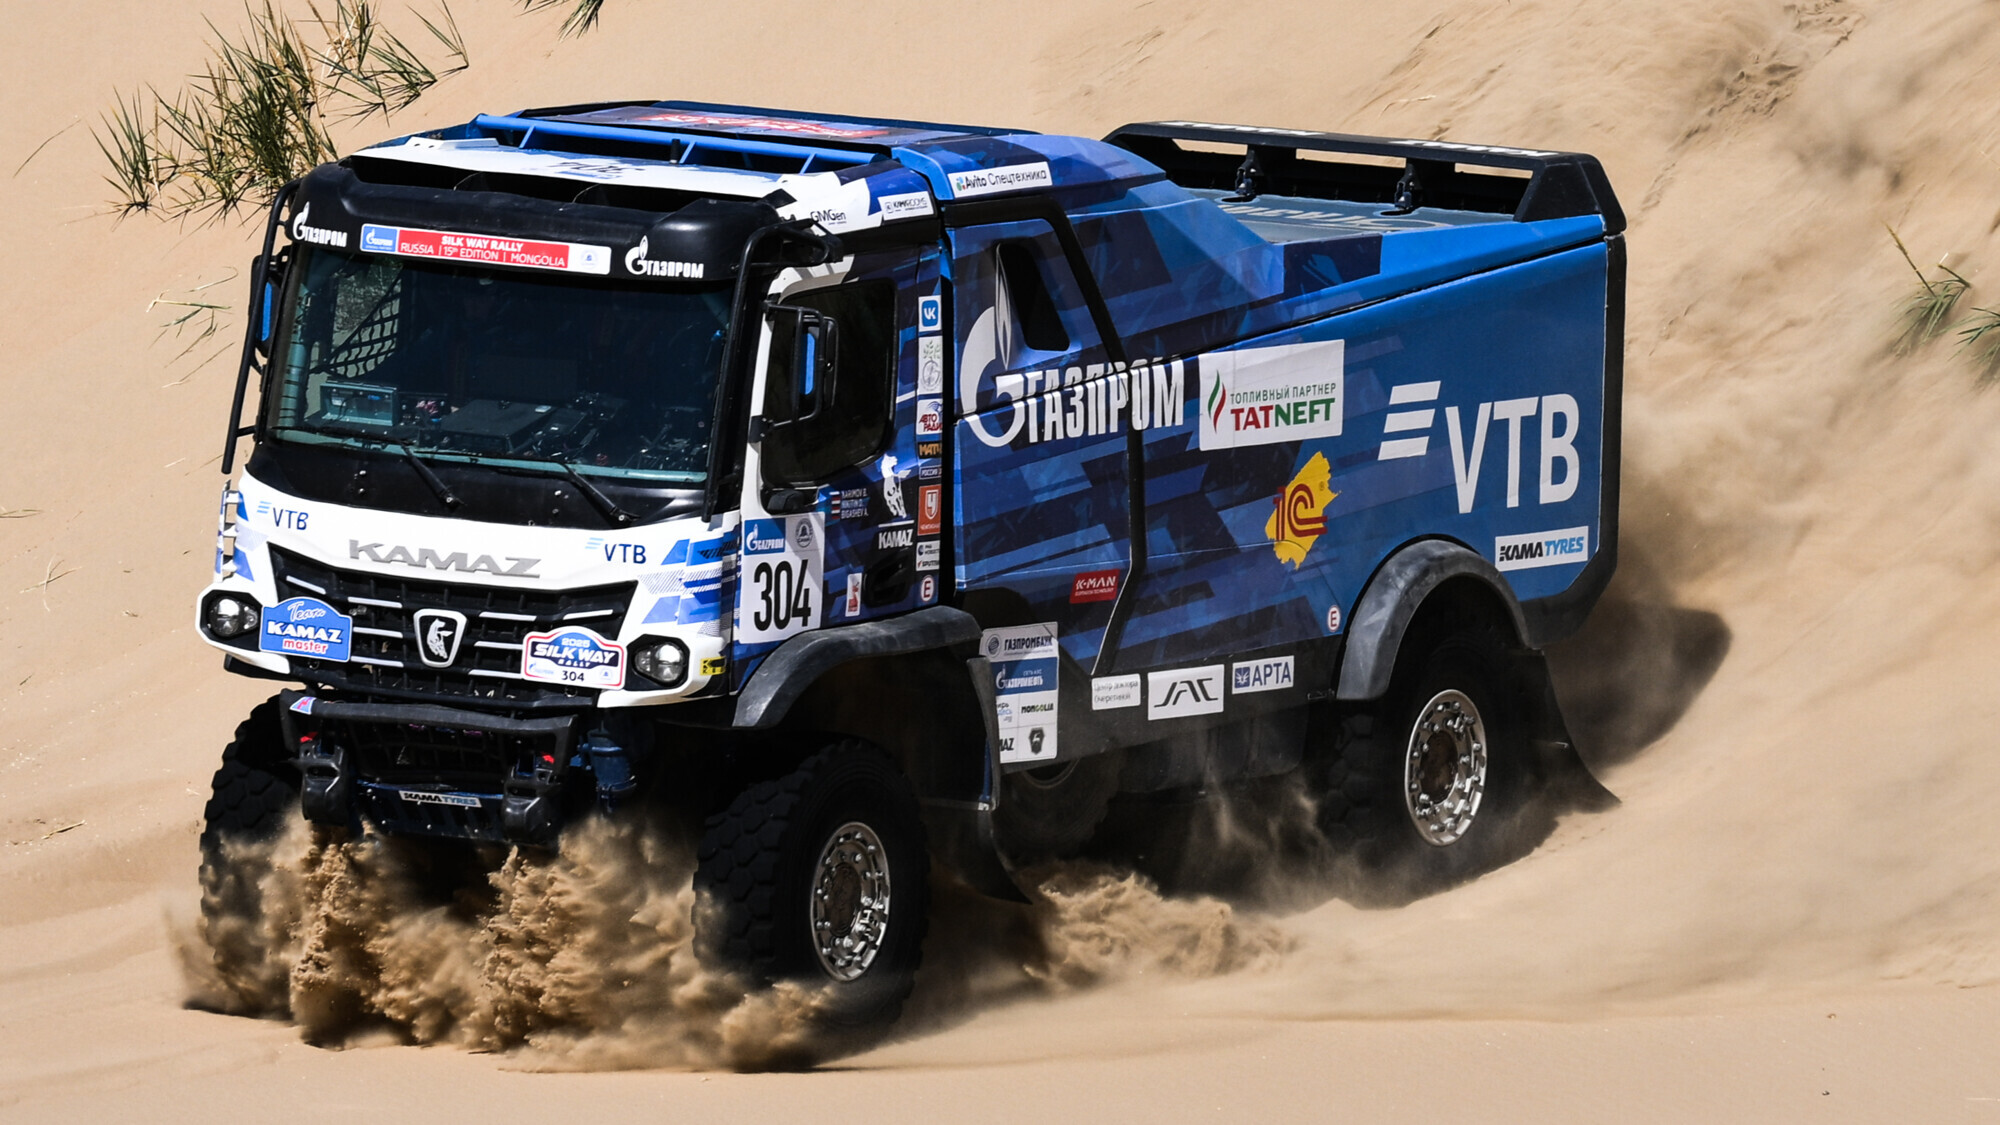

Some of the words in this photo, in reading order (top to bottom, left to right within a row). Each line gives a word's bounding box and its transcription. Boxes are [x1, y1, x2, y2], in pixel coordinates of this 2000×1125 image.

[965, 174, 987, 189] Avito
[988, 170, 1047, 186] Спецтехника
[810, 209, 846, 222] GMGen
[441, 235, 464, 247] SILK
[466, 237, 490, 249] WAY
[490, 239, 524, 252] RALLY
[400, 242, 434, 255] RUSSIA
[460, 247, 499, 261] EDITION
[510, 252, 566, 267] MONGOLIA
[924, 307, 936, 319] VK
[1230, 385, 1290, 404] ТОПЛИВНЫЙ
[1292, 382, 1336, 397] ПАРТНЕР
[919, 413, 937, 424] АВТО
[1230, 398, 1336, 431] TATNEFT
[923, 422, 942, 432] РАДИ
[1445, 393, 1580, 514] VTB
[272, 507, 309, 530] VTB
[757, 538, 785, 551] GAZPROM
[878, 528, 913, 550] KAMAZ
[349, 539, 541, 578] KAMAZ
[604, 543, 647, 564] VTB
[753, 559, 811, 631] 304
[287, 601, 327, 622] Team
[267, 620, 343, 644] KAMAZ
[283, 638, 328, 655] master
[561, 637, 590, 648] 2025
[533, 643, 577, 660] SILK
[578, 648, 616, 664] WAY
[557, 658, 591, 667] RALLY
[561, 670, 585, 682] 304
[1021, 702, 1054, 714] MONGOLIA
[999, 738, 1015, 752] MAZ
